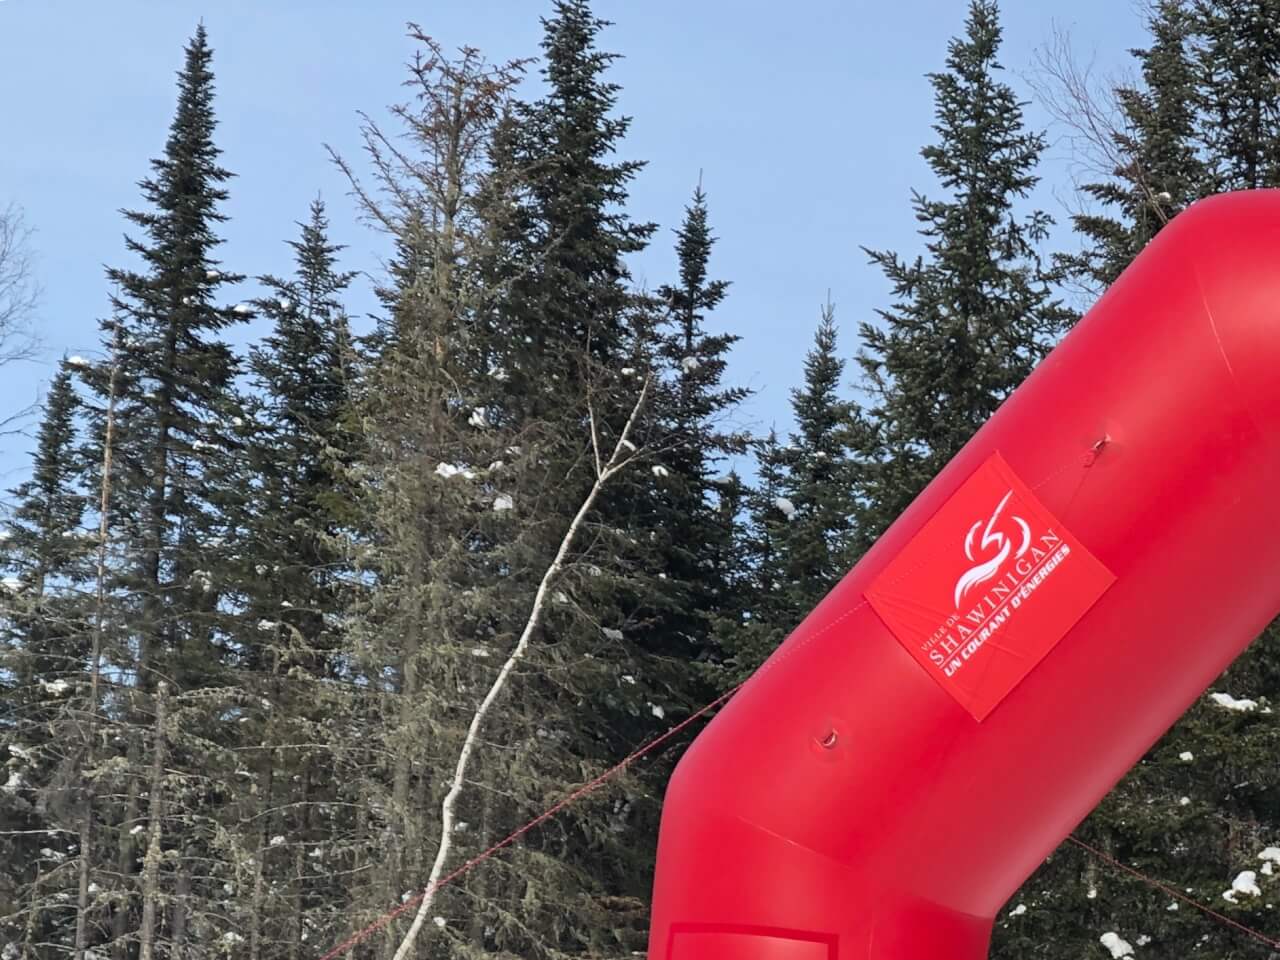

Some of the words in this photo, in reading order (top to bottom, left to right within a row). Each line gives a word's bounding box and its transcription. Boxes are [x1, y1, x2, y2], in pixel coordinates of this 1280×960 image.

[921, 626, 946, 652] VILLE
[928, 528, 1061, 667] SHAWINIGAN
[943, 658, 963, 678] UN
[961, 606, 1012, 662] COURANT
[1011, 543, 1073, 610] D'ÉNERGIES
